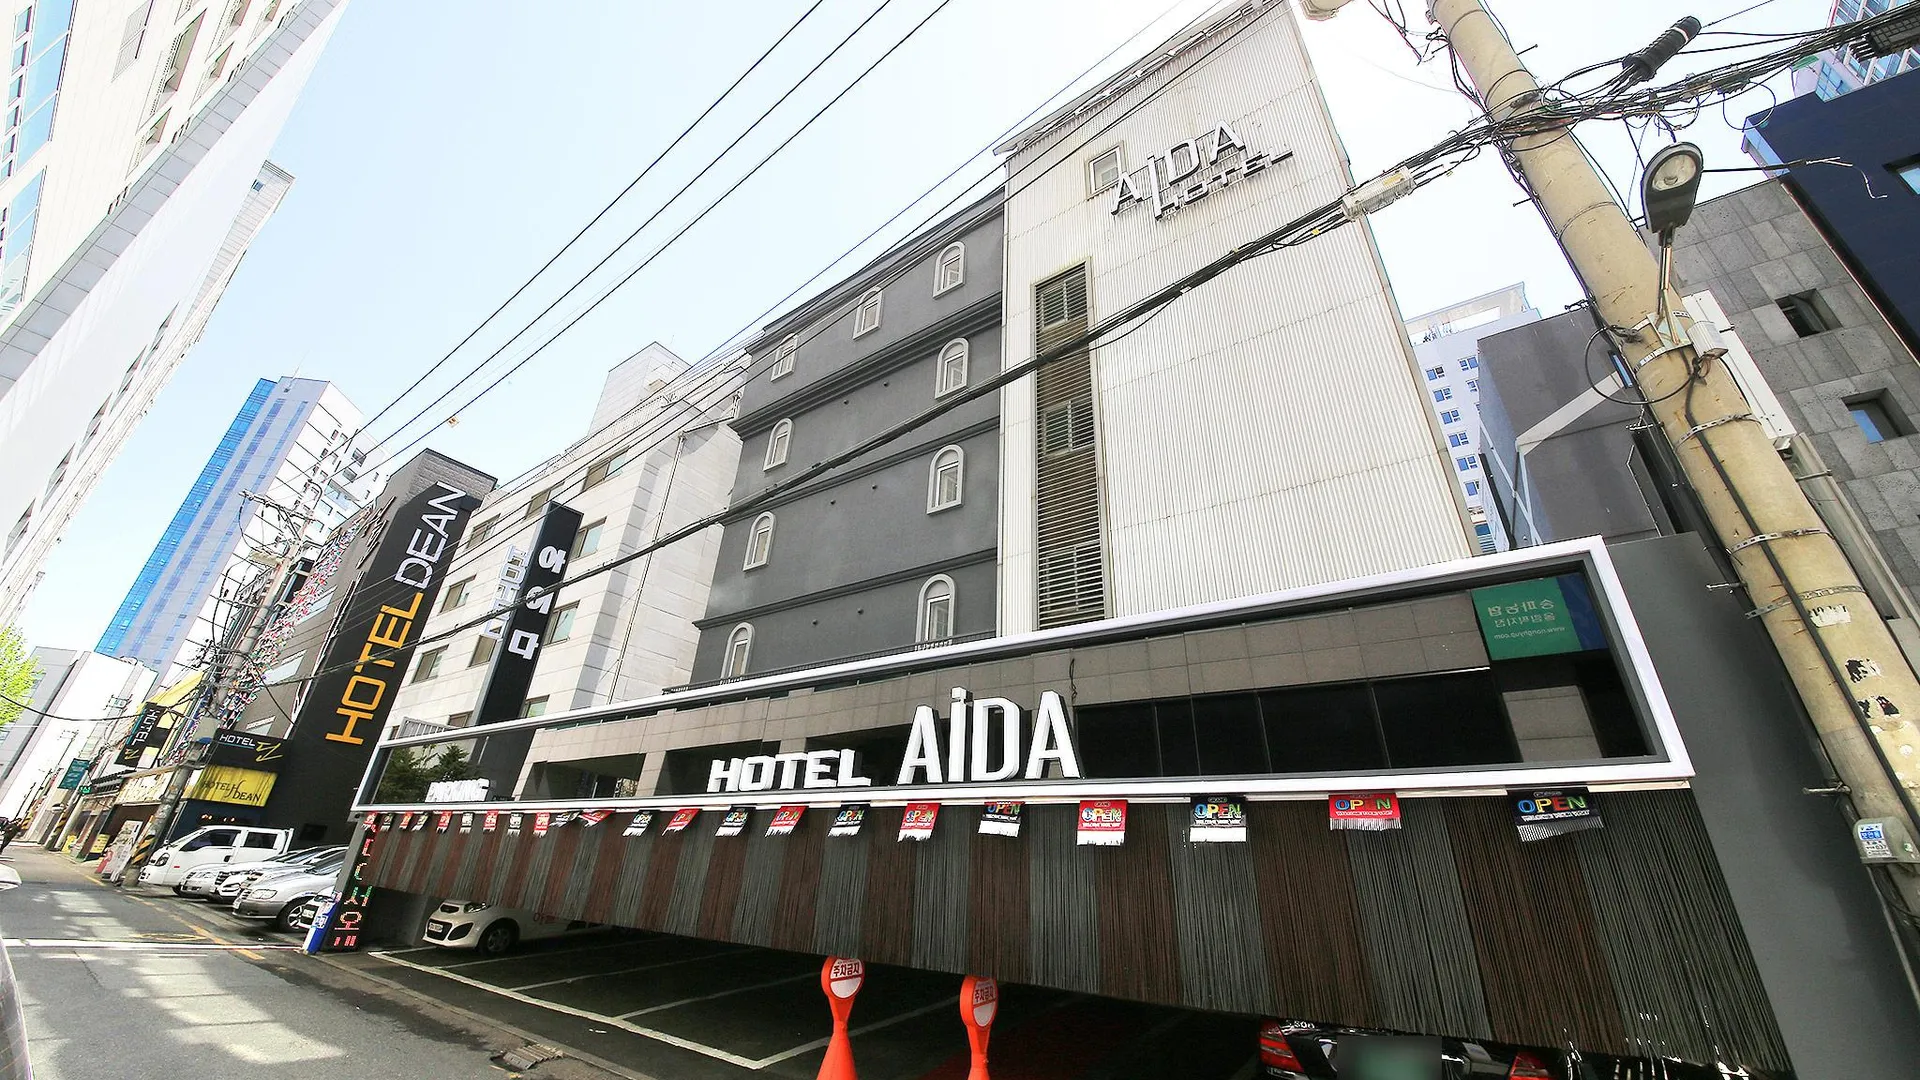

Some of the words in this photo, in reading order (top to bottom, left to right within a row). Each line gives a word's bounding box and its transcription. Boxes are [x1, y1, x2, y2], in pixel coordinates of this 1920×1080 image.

[325, 592, 424, 746] HOTEL
[394, 481, 467, 590] DEAN
[219, 733, 256, 747] HOTEL
[706, 748, 872, 793] HOTEL
[232, 791, 262, 803] DEAN
[1335, 798, 1391, 810] OPN
[987, 802, 1021, 815] OPEN
[1194, 803, 1242, 819] OPEN
[1517, 796, 1587, 814] OPEN
[1081, 807, 1122, 822] OPEN
[833, 962, 860, 977] 주차금지
